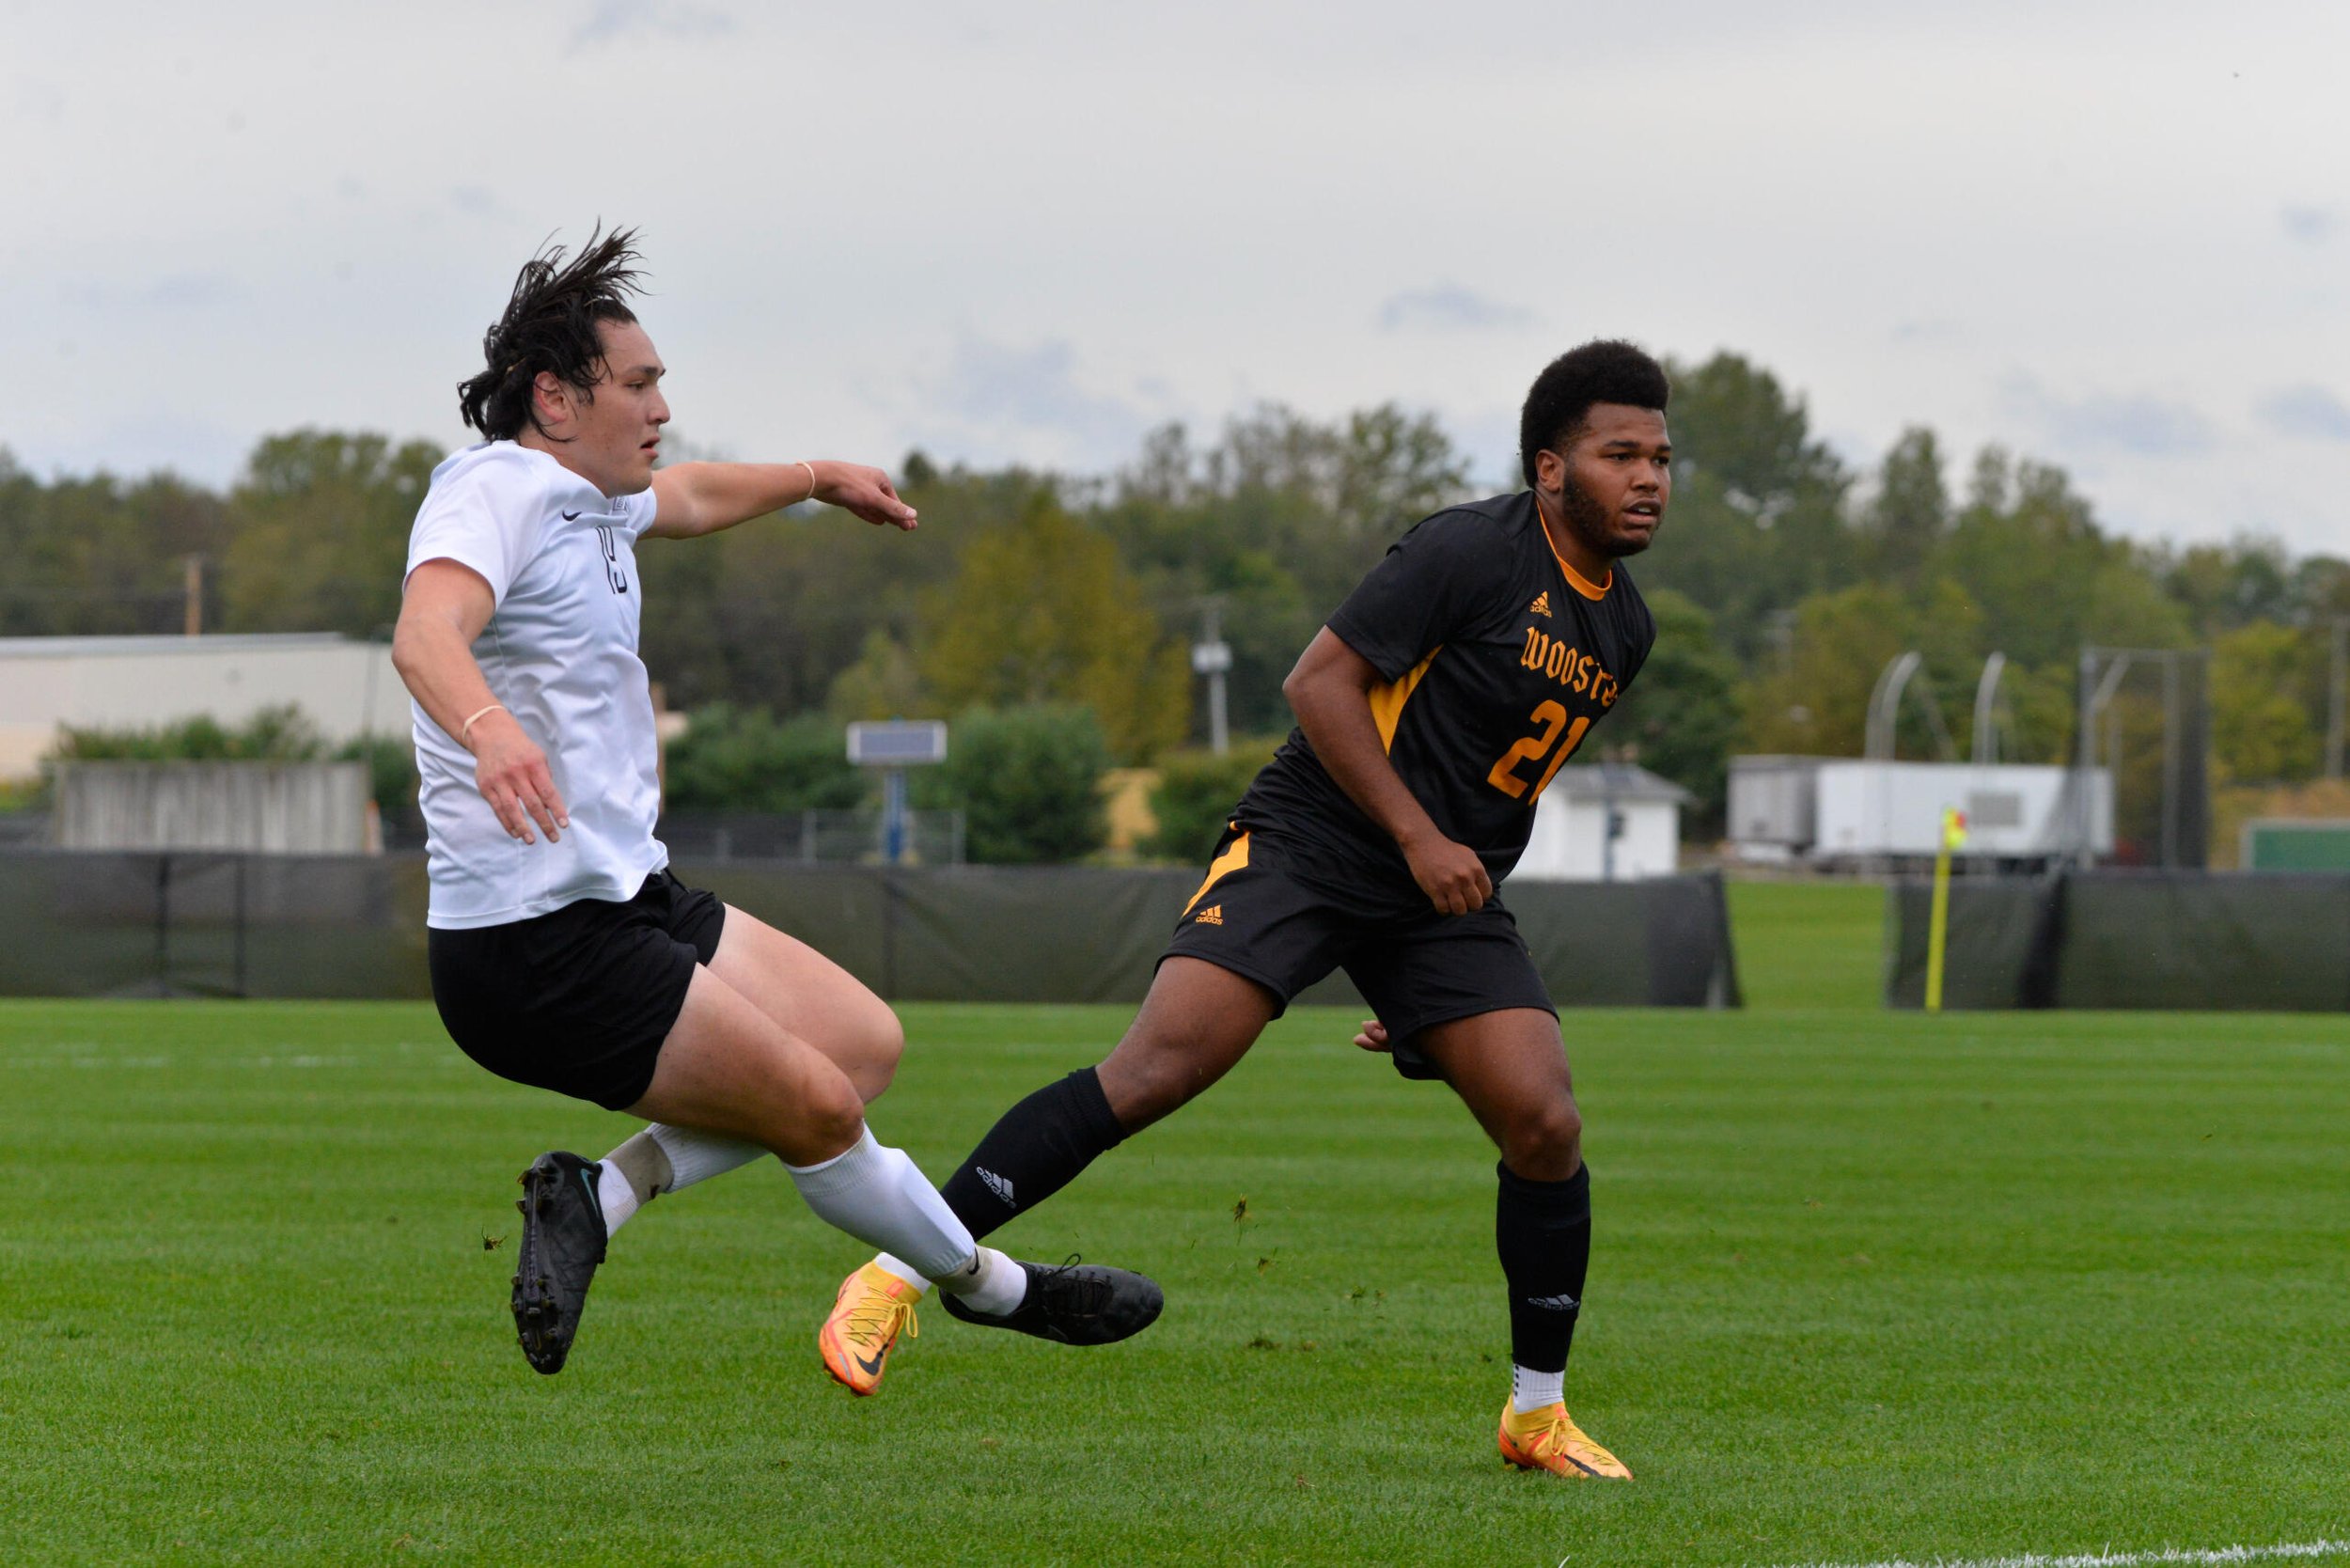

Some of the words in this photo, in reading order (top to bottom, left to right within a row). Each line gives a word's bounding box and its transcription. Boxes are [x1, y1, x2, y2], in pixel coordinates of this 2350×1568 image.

[1487, 699, 1590, 806] 21
[1196, 915, 1224, 926] adidas
[976, 1167, 1017, 1210] adidas
